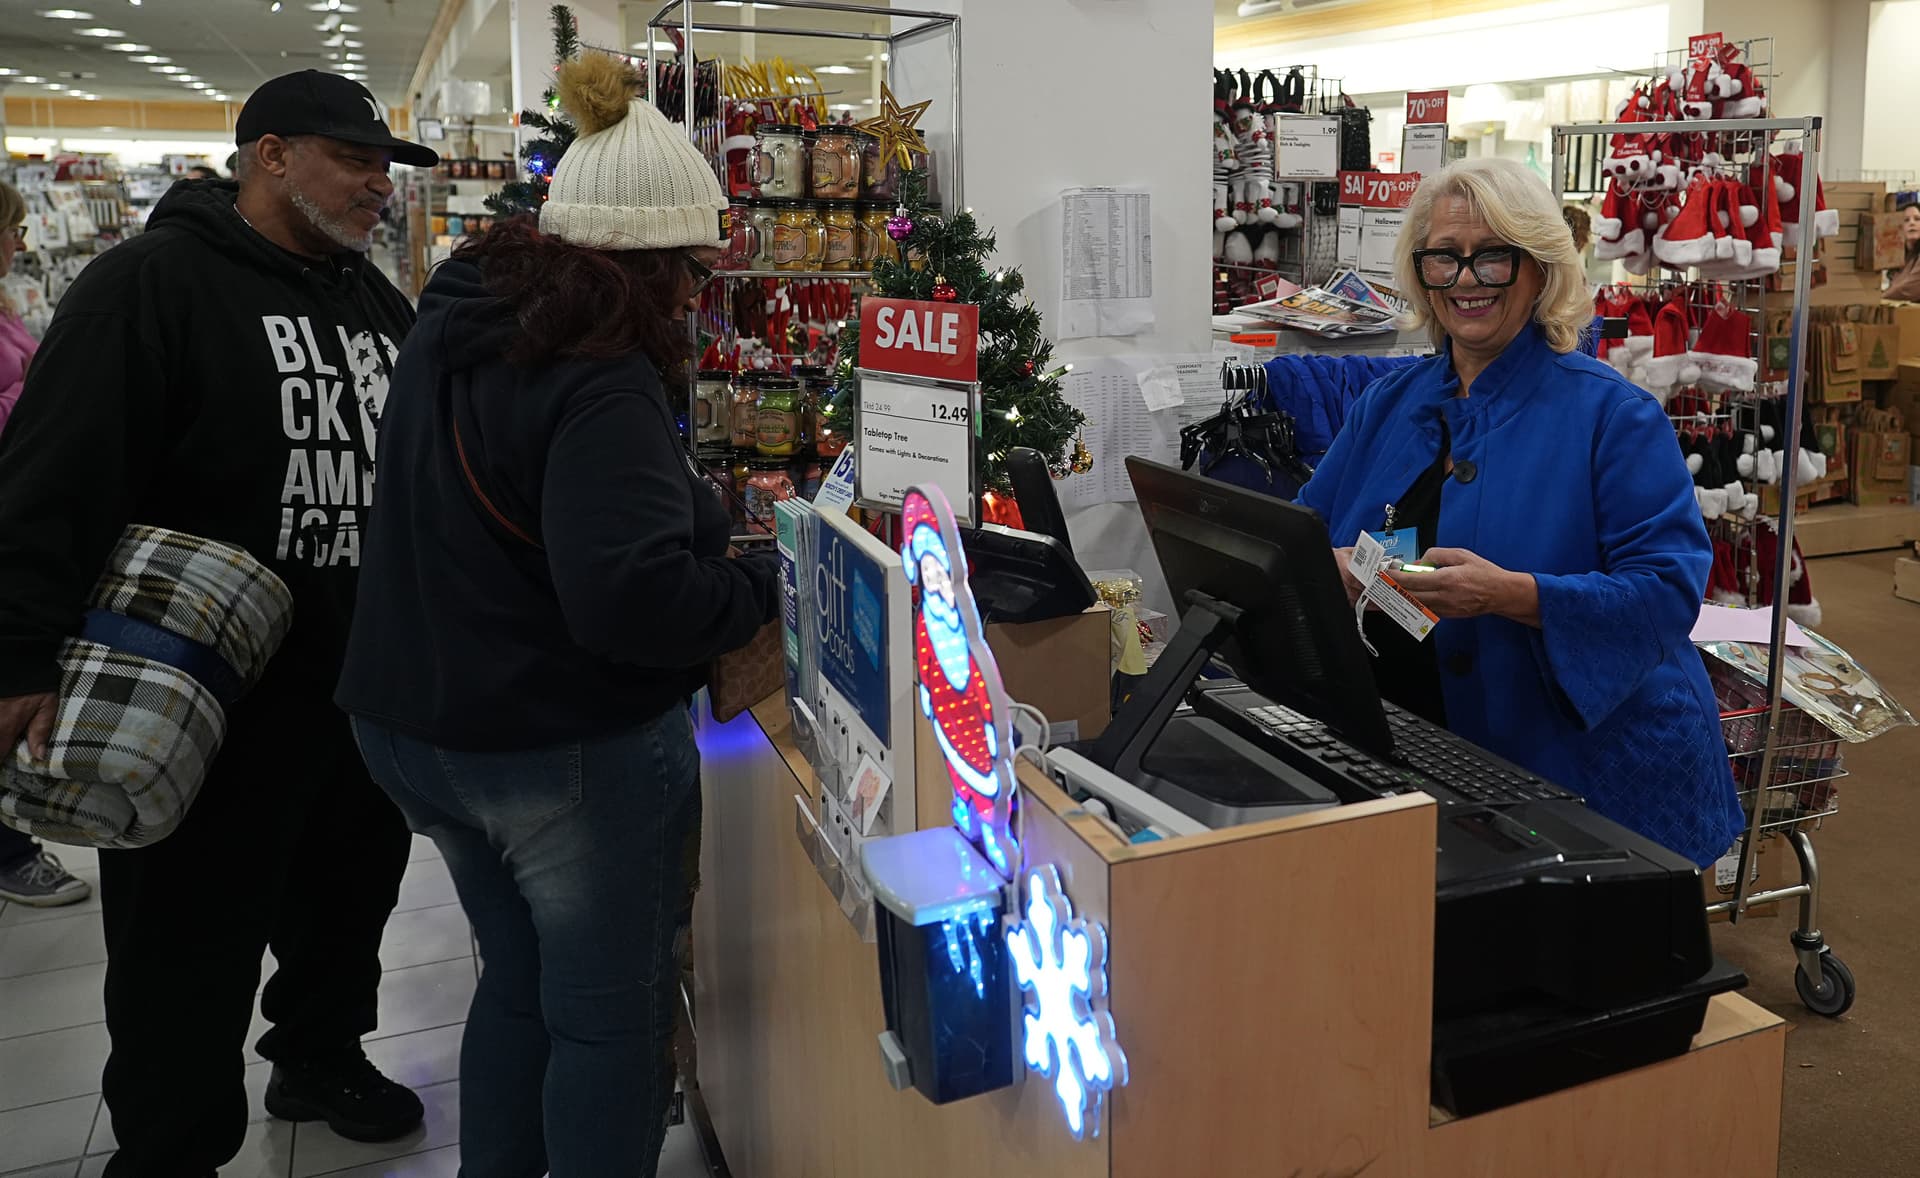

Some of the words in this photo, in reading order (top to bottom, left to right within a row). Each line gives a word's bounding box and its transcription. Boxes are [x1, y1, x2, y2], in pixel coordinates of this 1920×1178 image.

[1408, 99, 1430, 119] 70%
[1431, 98, 1444, 108] OFF
[1322, 127, 1337, 135] 1.99
[1367, 181, 1398, 202] 70%
[1398, 181, 1416, 192] OFF
[875, 306, 959, 355] SALE
[280, 376, 351, 441] CK
[931, 403, 968, 423] 12.49
[864, 427, 892, 441] Tabletop
[894, 432, 908, 442] Tree
[868, 444, 884, 453] Comes
[897, 449, 911, 458] Lights
[917, 452, 949, 463] Decorations
[815, 536, 847, 644] gift
[828, 627, 856, 675] cards
